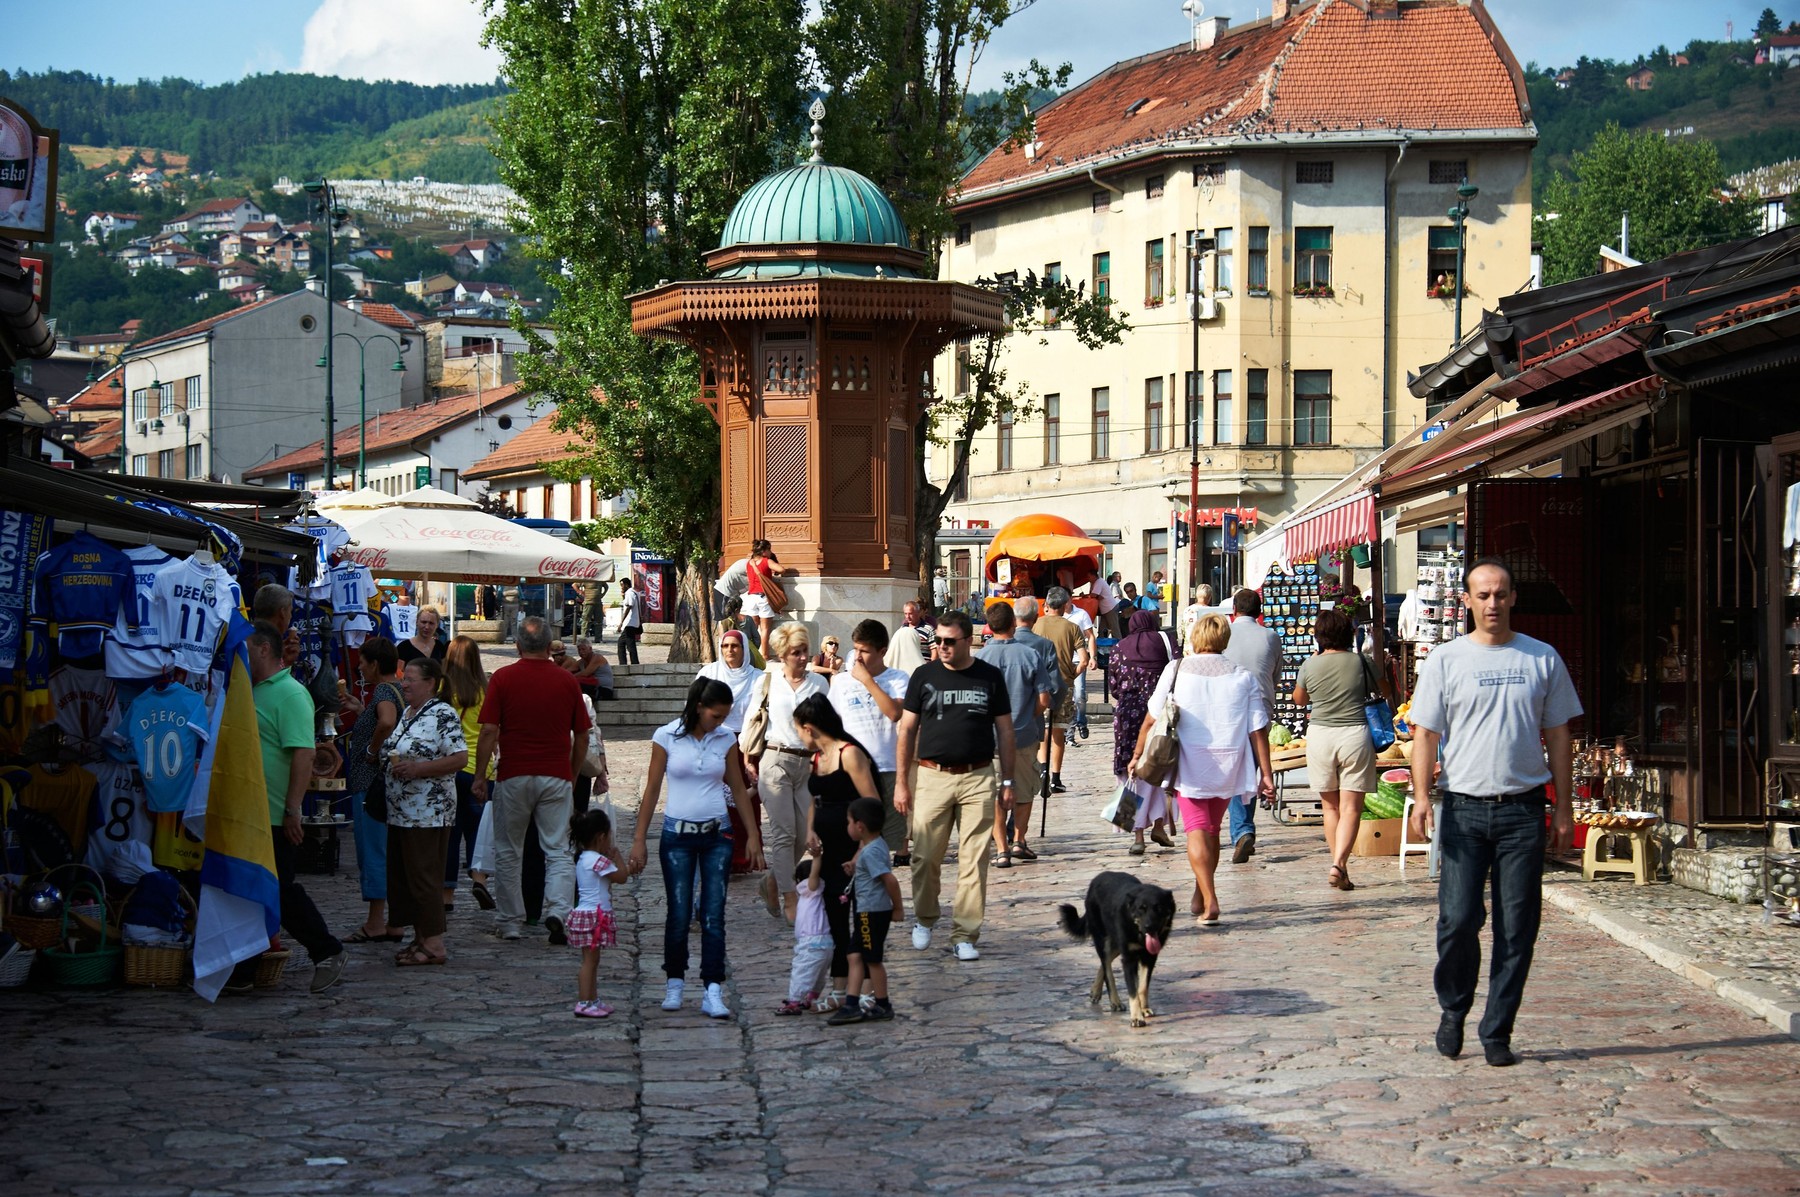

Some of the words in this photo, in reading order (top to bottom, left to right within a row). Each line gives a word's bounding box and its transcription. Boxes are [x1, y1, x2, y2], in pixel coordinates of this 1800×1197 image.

[0, 162, 26, 182] sko
[72, 552, 101, 564] BOSNA
[538, 556, 600, 578] Coca-Cola
[63, 574, 113, 588] HERZEGOVINA
[343, 581, 358, 605] 11
[180, 603, 206, 643] 11
[398, 620, 409, 633] 11
[144, 730, 183, 780] 10
[105, 797, 135, 841] 8
